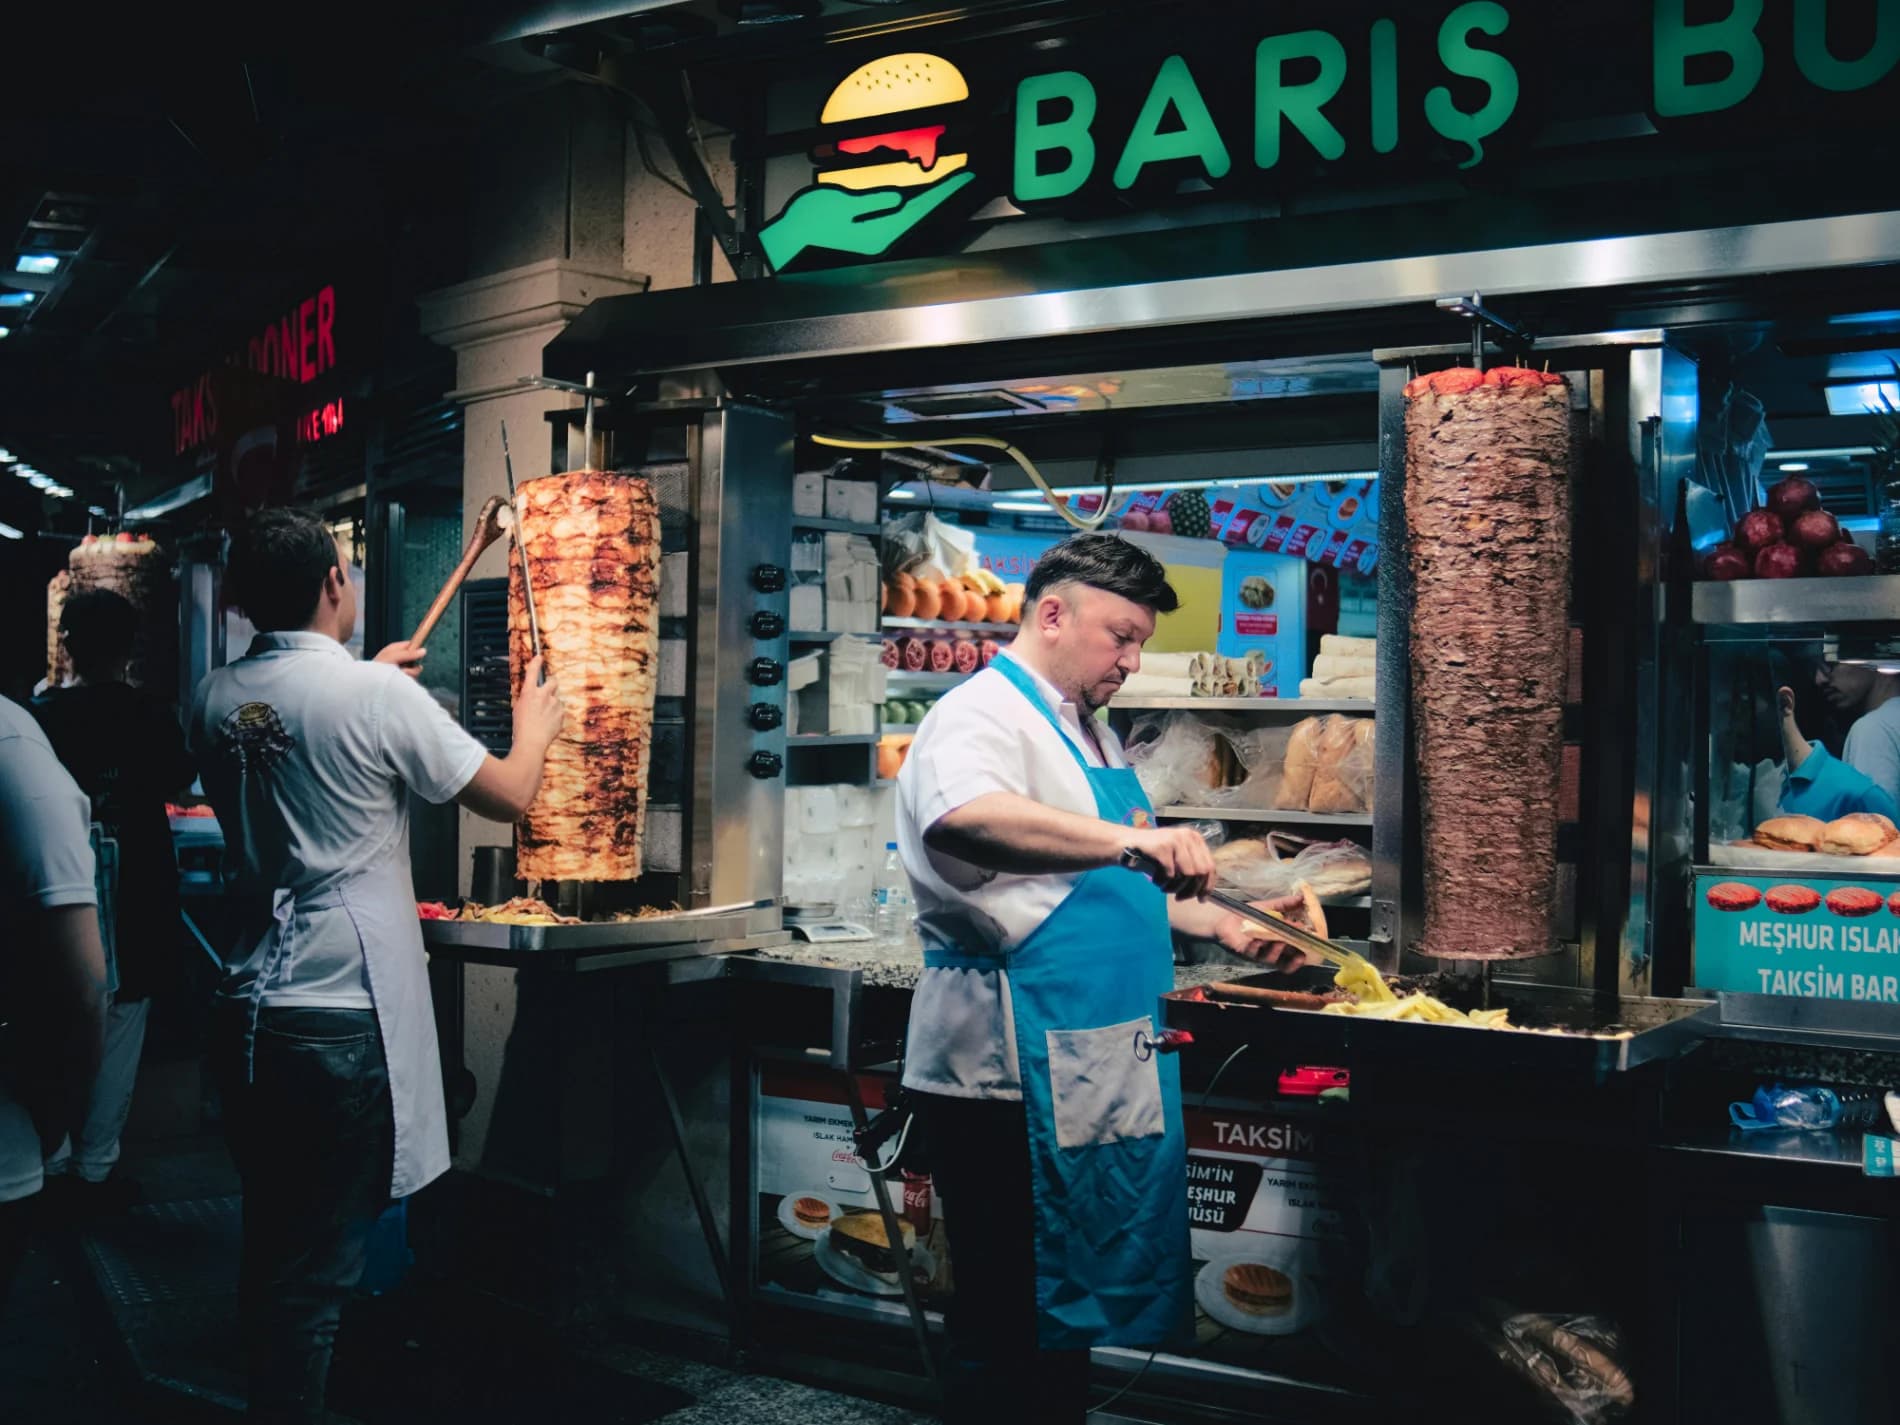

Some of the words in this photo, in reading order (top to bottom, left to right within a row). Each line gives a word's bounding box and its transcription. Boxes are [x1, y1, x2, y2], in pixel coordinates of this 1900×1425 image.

[1013, 1, 1519, 203] BARIŞ
[1738, 920, 1835, 955] MEŞHUR
[1757, 963, 1845, 999] TAKSİM
[1850, 973, 1899, 1002] BAR
[1212, 1121, 1315, 1152] TAKSİM
[1185, 1161, 1234, 1183] SİM'İN
[1187, 1185, 1236, 1205] EŞHUR
[1188, 1204, 1225, 1224] ÜSÜ
